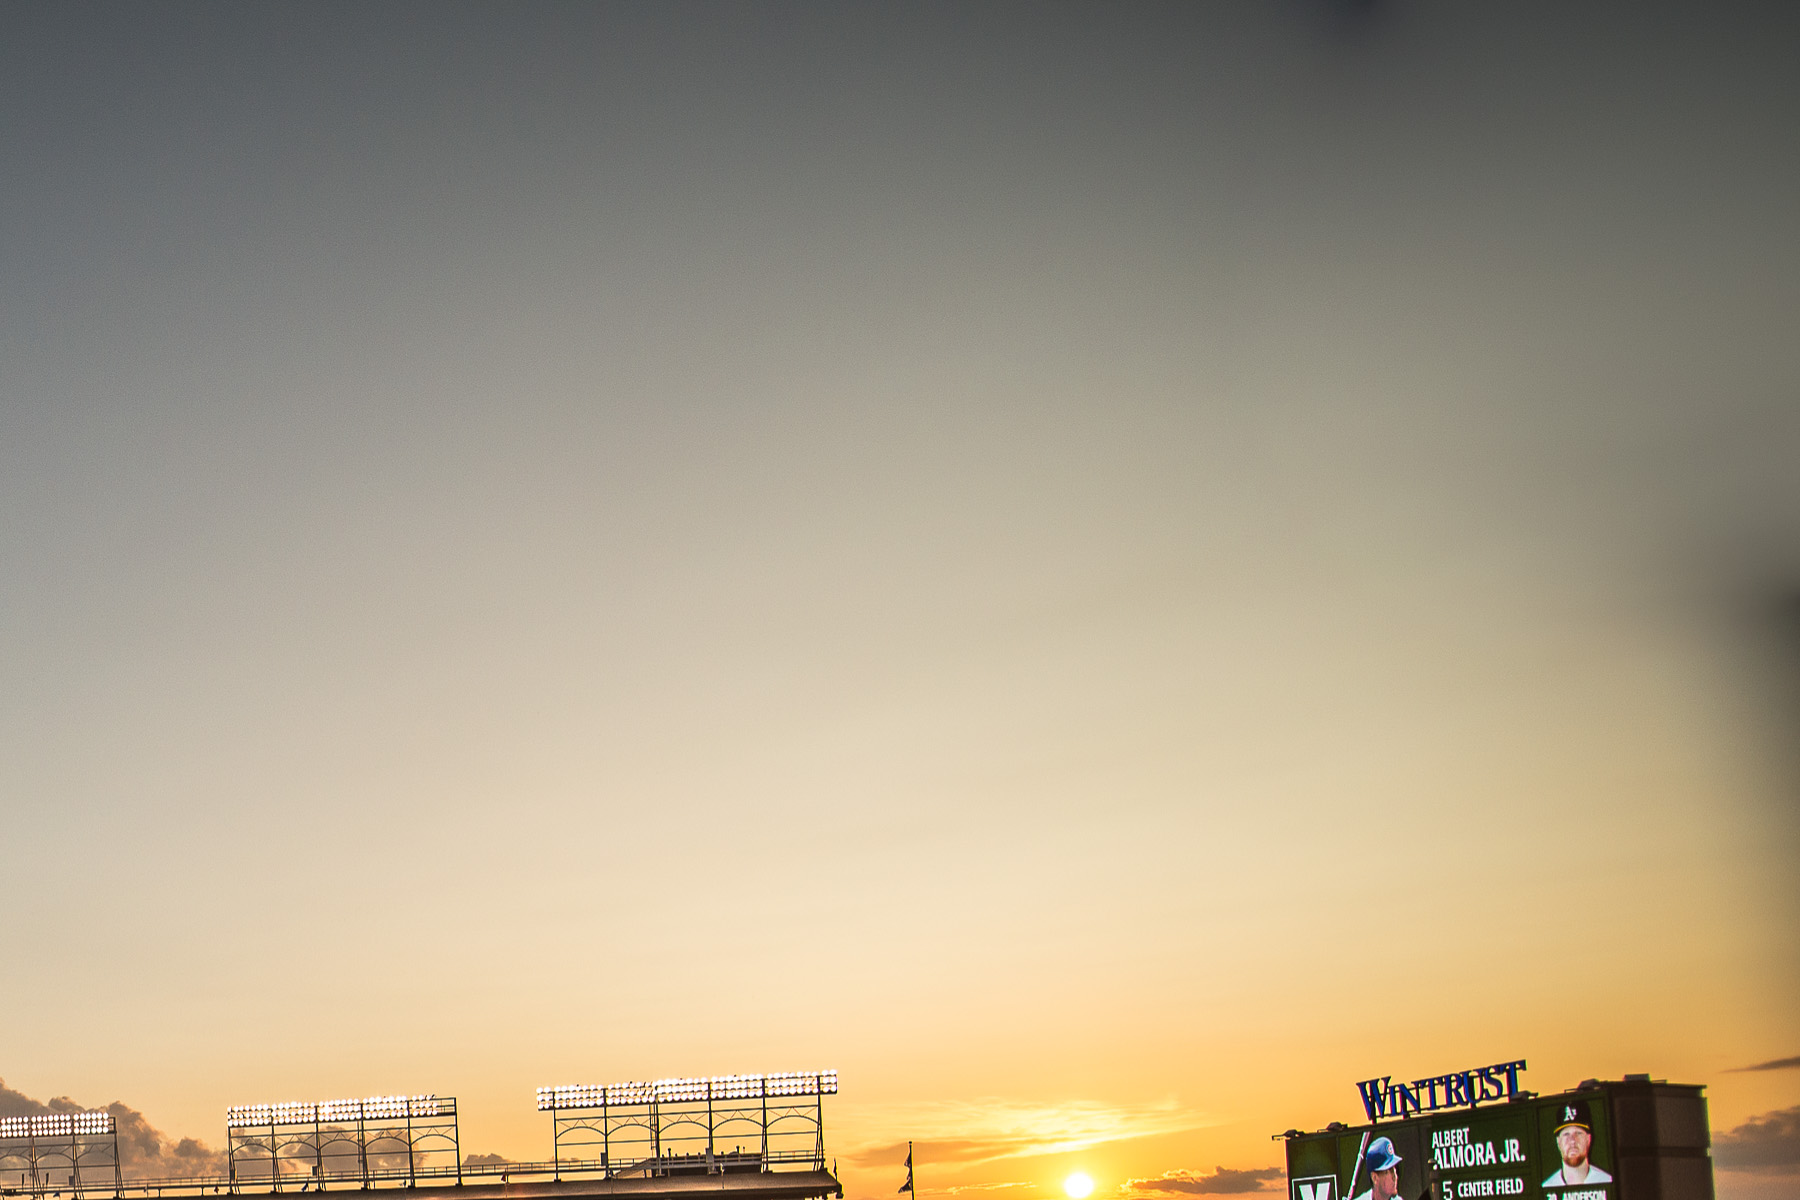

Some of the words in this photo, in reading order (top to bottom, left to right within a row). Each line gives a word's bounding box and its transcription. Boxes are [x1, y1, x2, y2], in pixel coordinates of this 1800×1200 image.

[1356, 1059, 1526, 1120] WINTRUST
[1432, 1127, 1469, 1149] ALBERT
[1433, 1141, 1497, 1170] ALMORA
[1499, 1138, 1526, 1163] JR.
[1457, 1180, 1494, 1198] CENTER
[1495, 1177, 1524, 1195] FIELD
